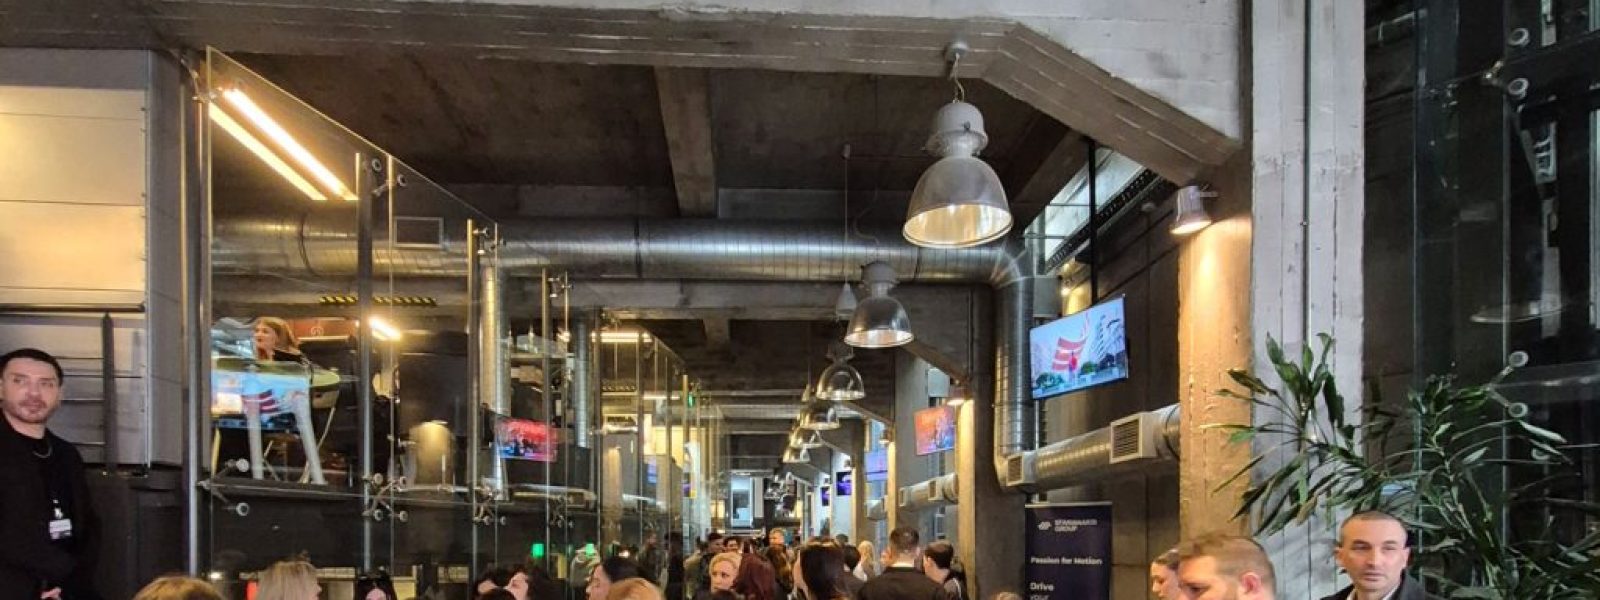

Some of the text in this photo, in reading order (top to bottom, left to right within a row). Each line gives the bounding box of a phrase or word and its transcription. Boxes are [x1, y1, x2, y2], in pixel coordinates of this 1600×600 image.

[1030, 556, 1104, 565] Passion for Motion
[1030, 582, 1055, 592] Drive
